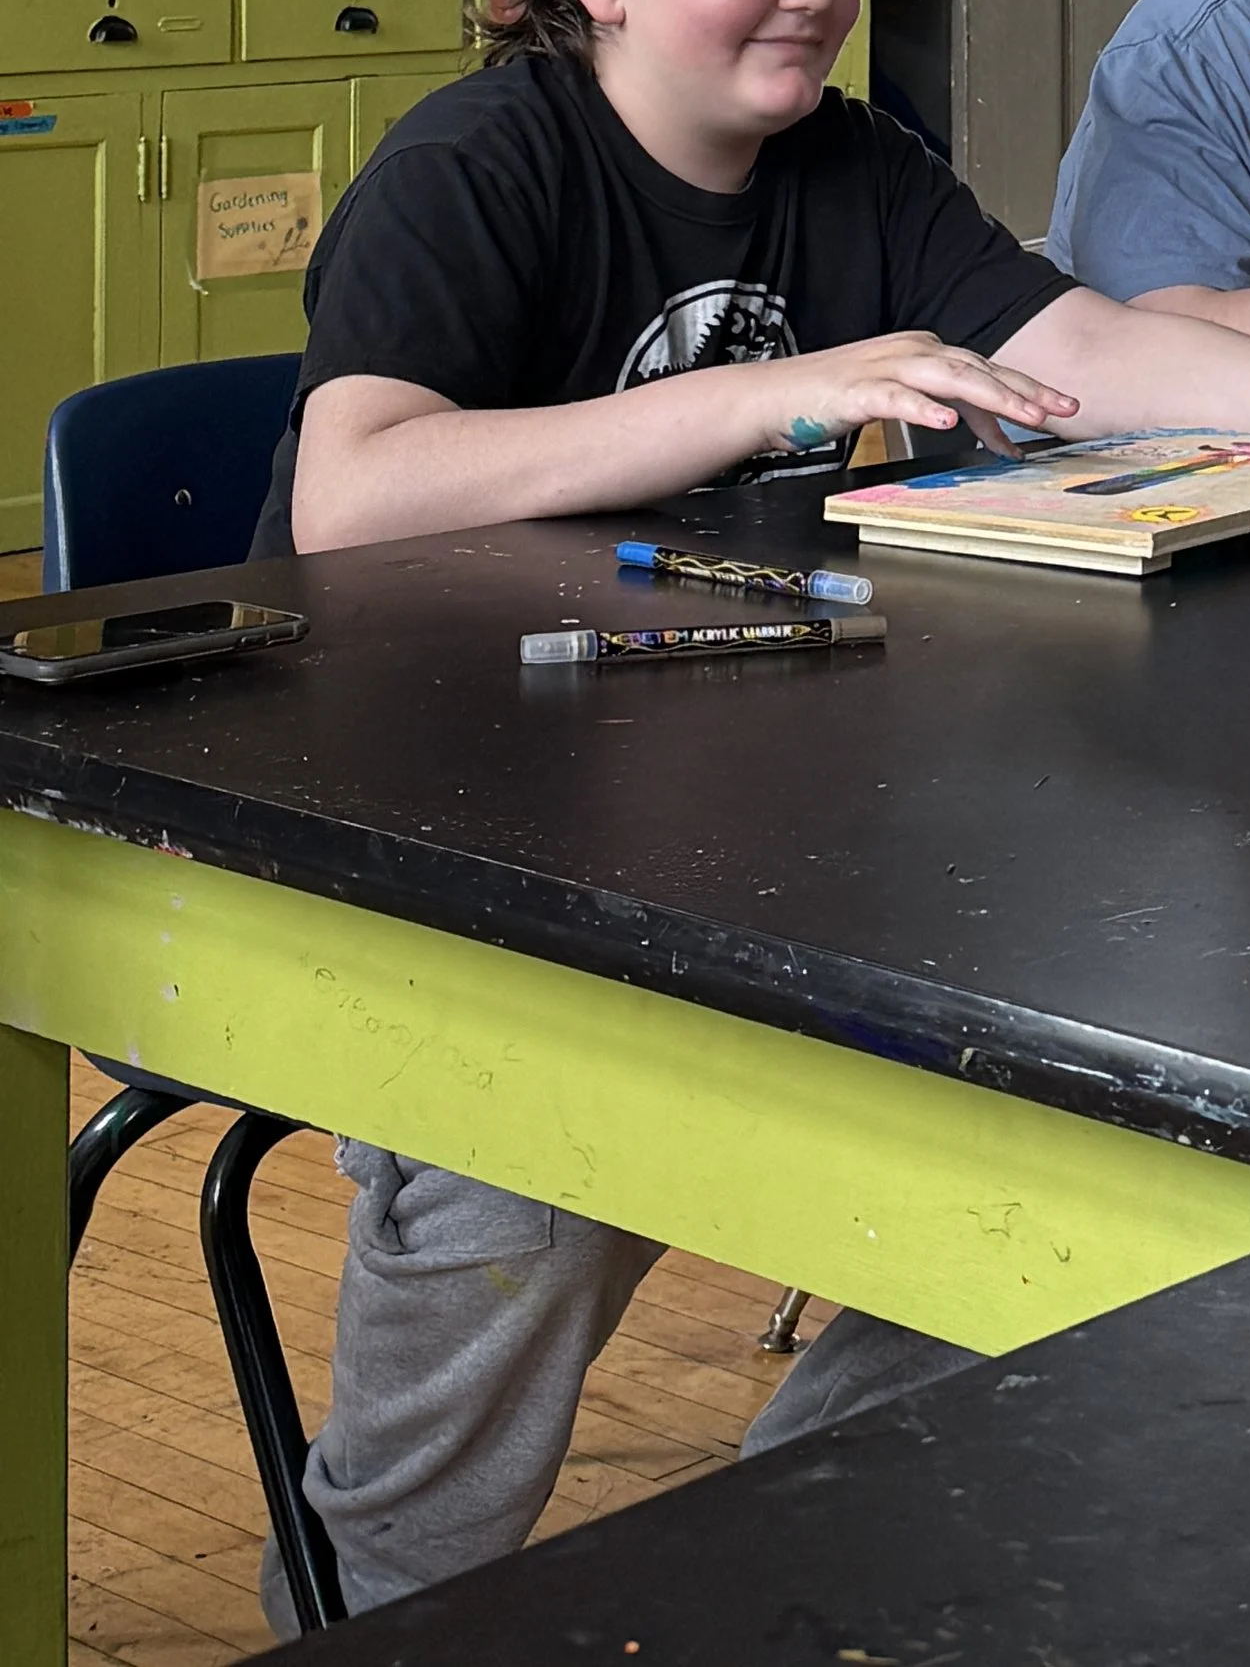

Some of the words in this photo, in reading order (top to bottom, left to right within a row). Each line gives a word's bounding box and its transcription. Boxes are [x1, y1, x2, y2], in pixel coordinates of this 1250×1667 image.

[209, 190, 288, 213] Gardening
[218, 220, 276, 239] Supplies
[692, 627, 740, 642] ACRYLIC
